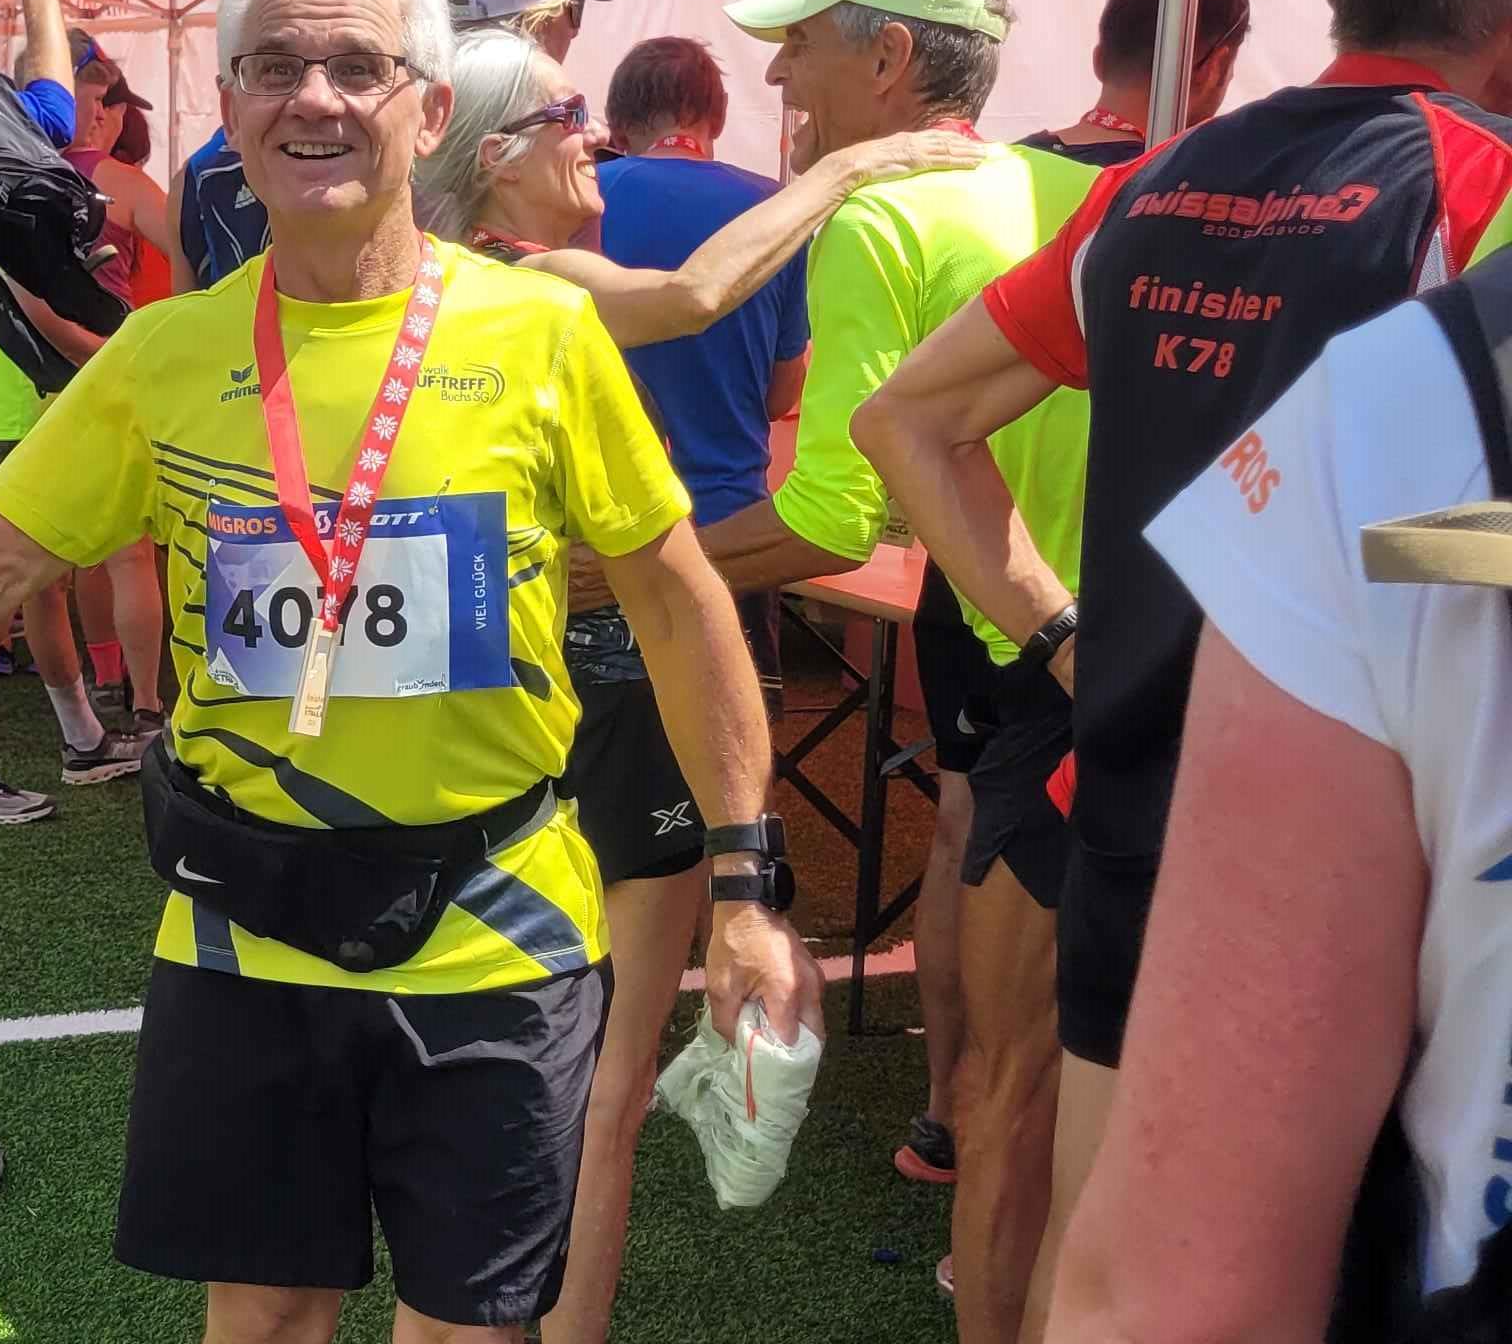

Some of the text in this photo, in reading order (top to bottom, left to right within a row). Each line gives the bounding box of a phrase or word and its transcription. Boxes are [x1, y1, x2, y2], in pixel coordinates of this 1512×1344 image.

[1127, 181, 1346, 237] swissalpine
[1129, 274, 1283, 321] finisher
[1153, 333, 1236, 378] K78
[220, 383, 261, 402] erima
[416, 375, 487, 391] UF-TREFF
[441, 389, 490, 404] Buchs SG
[1223, 431, 1281, 514] ROS
[208, 511, 424, 535] MIGROS OTT
[471, 553, 487, 630] VIEL GLÜCK
